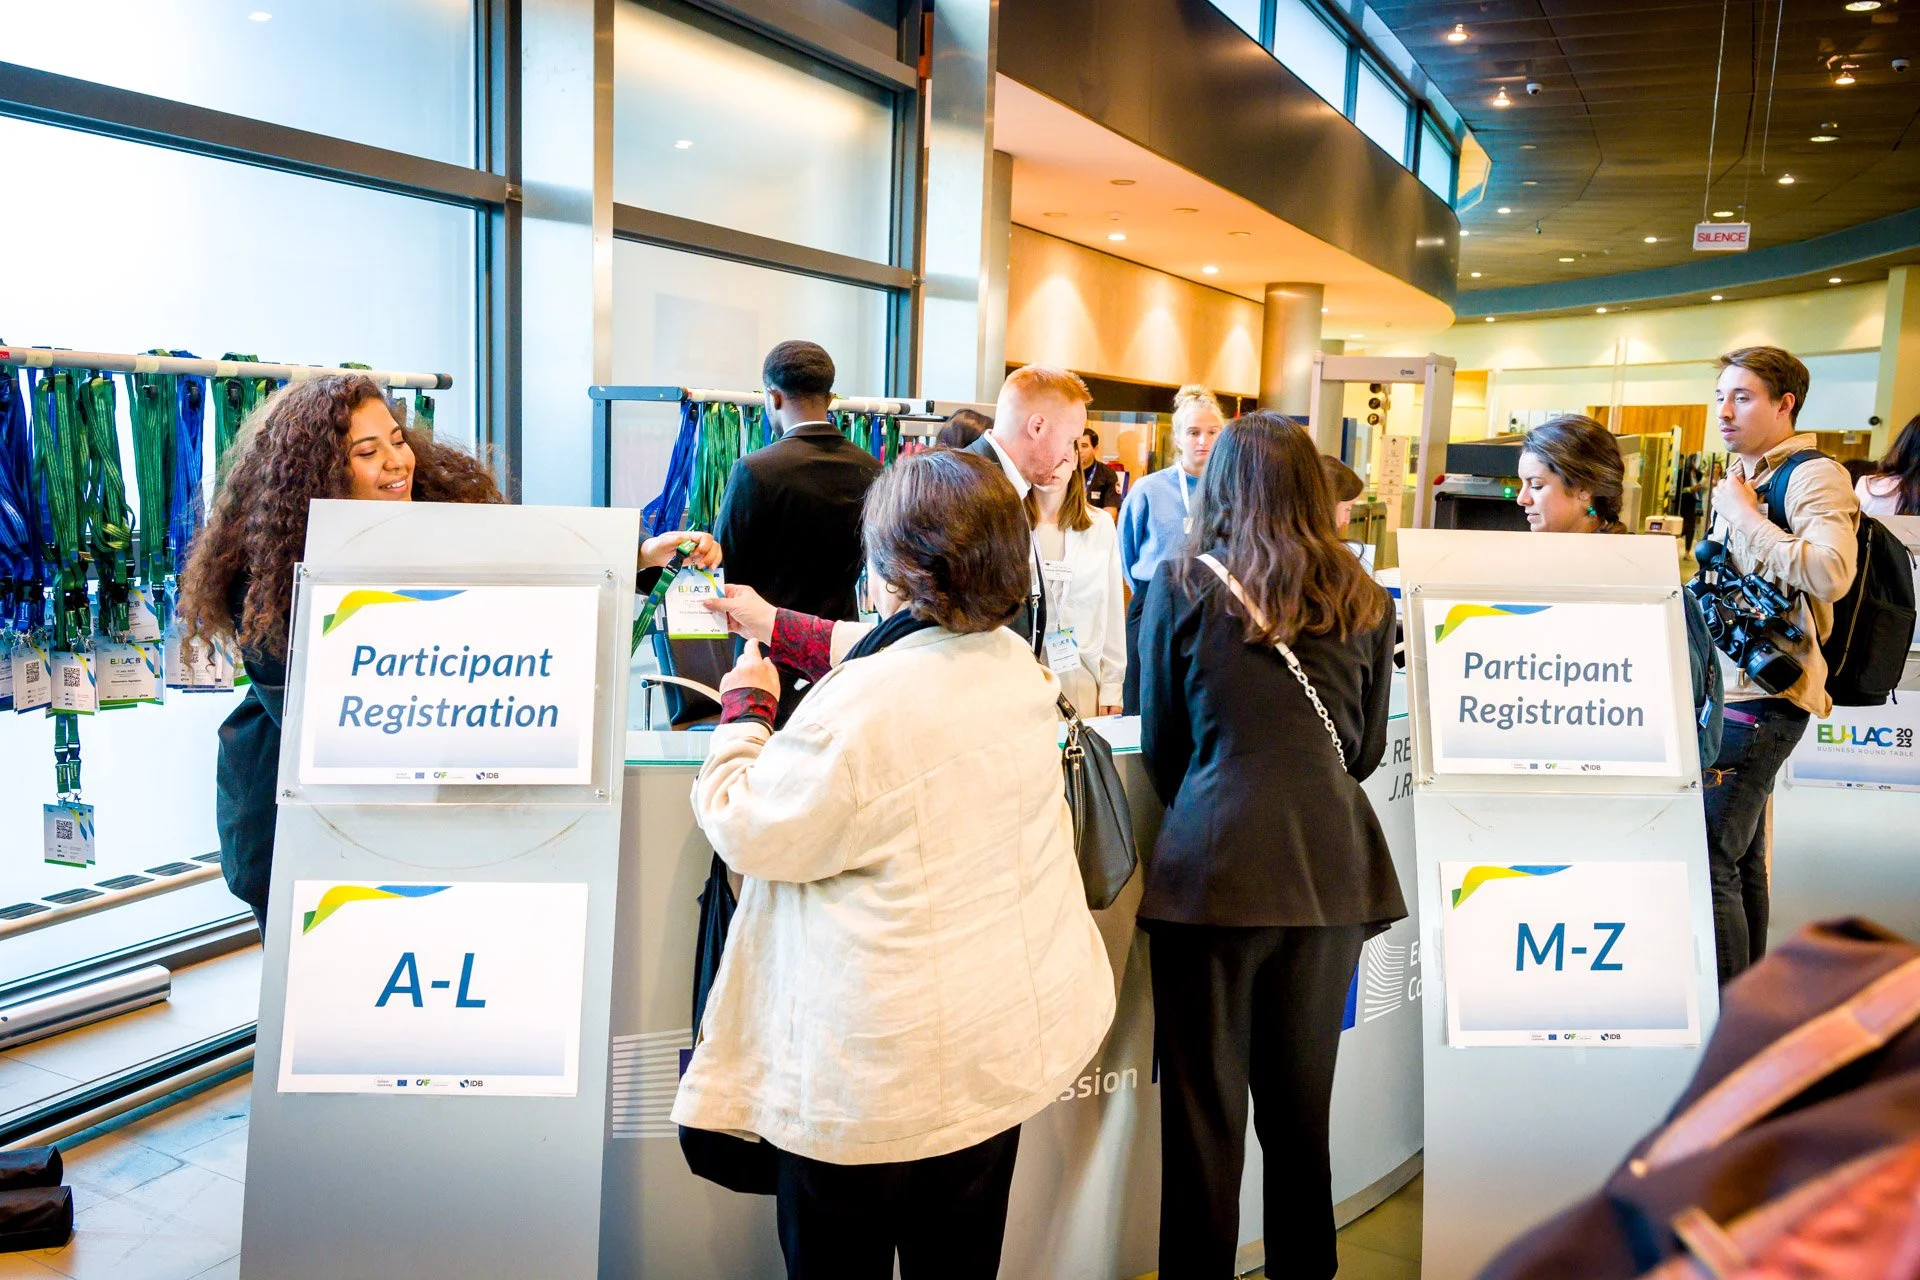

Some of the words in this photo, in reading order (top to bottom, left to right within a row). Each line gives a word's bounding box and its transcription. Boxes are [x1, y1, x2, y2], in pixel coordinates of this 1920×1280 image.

[1697, 232, 1746, 242] SILENCE
[351, 645, 553, 683] Participant
[1464, 652, 1633, 687] Participant
[338, 695, 559, 734] Registration
[1459, 695, 1644, 730] Registration
[1896, 728, 1913, 738] 20
[1896, 738, 1912, 748] 23
[1516, 922, 1626, 971] M-Z
[374, 952, 487, 1008] A-L
